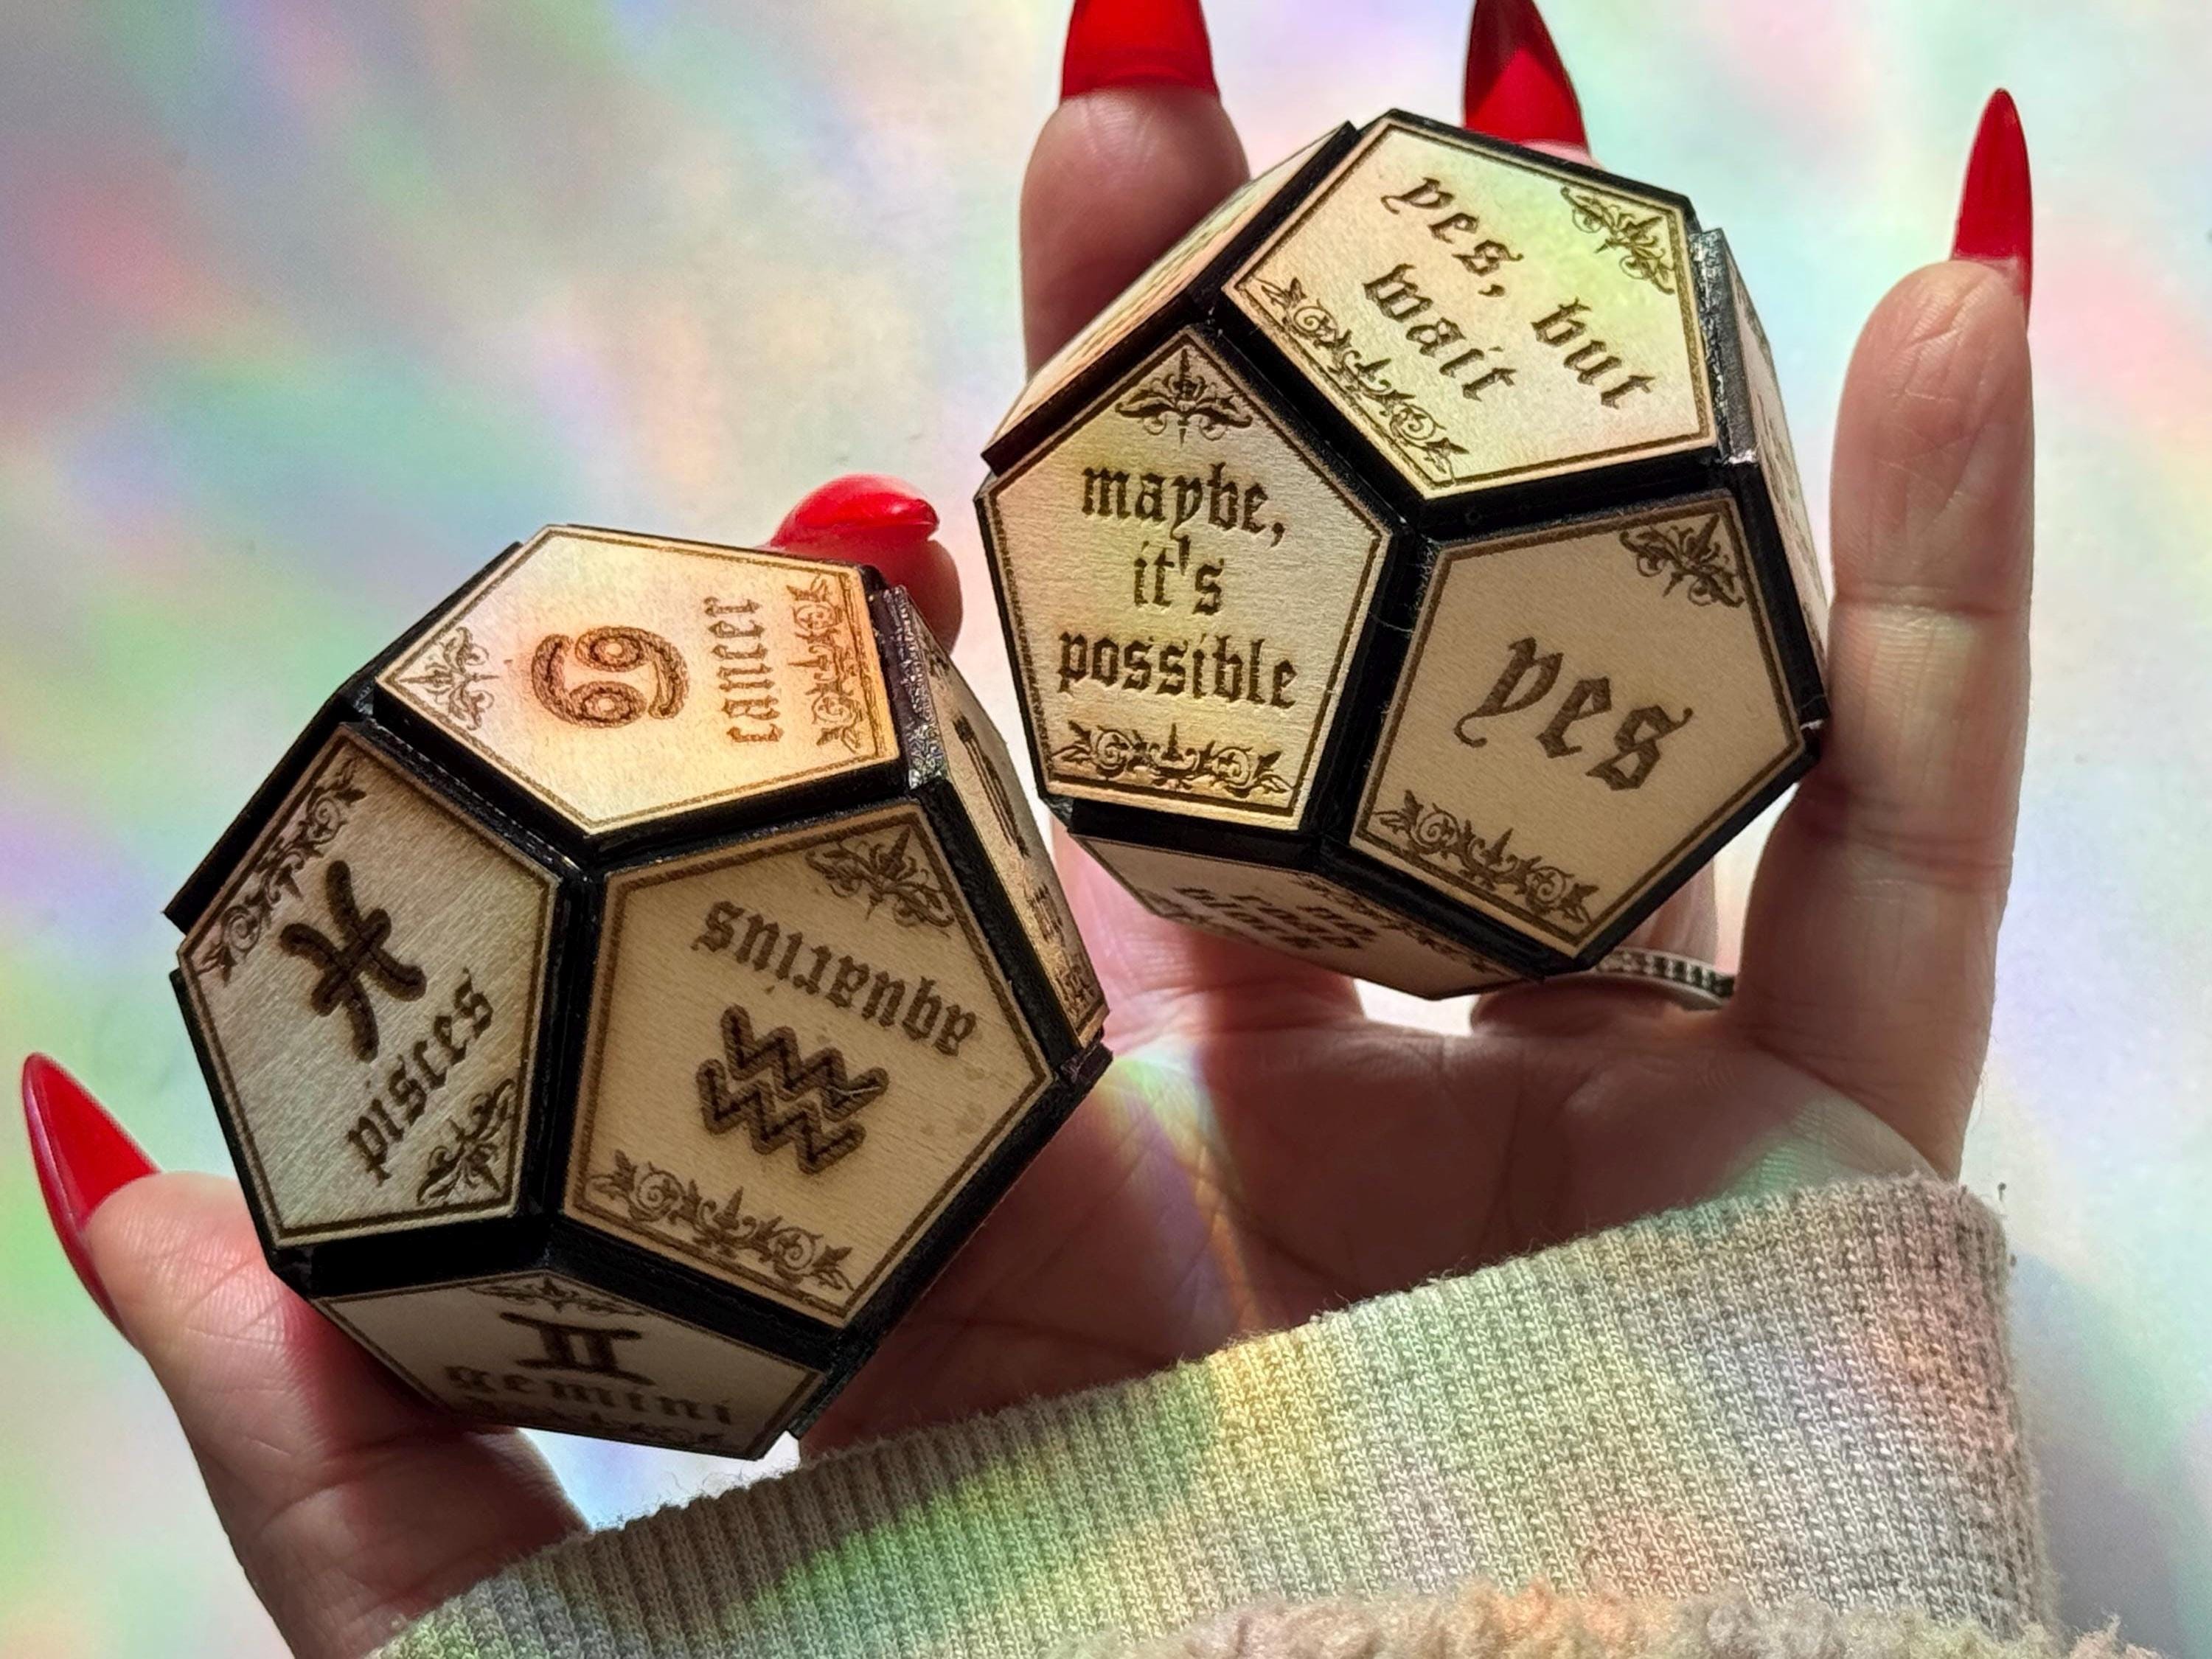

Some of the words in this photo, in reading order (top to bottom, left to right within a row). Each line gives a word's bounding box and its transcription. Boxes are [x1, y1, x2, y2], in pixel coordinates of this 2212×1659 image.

[1363, 263, 1517, 402] wait
[1381, 178, 1523, 297] yes,
[1531, 297, 1655, 409] but
[1082, 462, 1285, 546] maybe,
[1134, 534, 1224, 616] it's
[703, 596, 785, 744] cancer
[1057, 631, 1296, 709] possible
[1454, 637, 1694, 791] yes
[690, 900, 978, 1057] aquarius
[347, 967, 493, 1185] pisces
[443, 1365, 733, 1425] gemini
